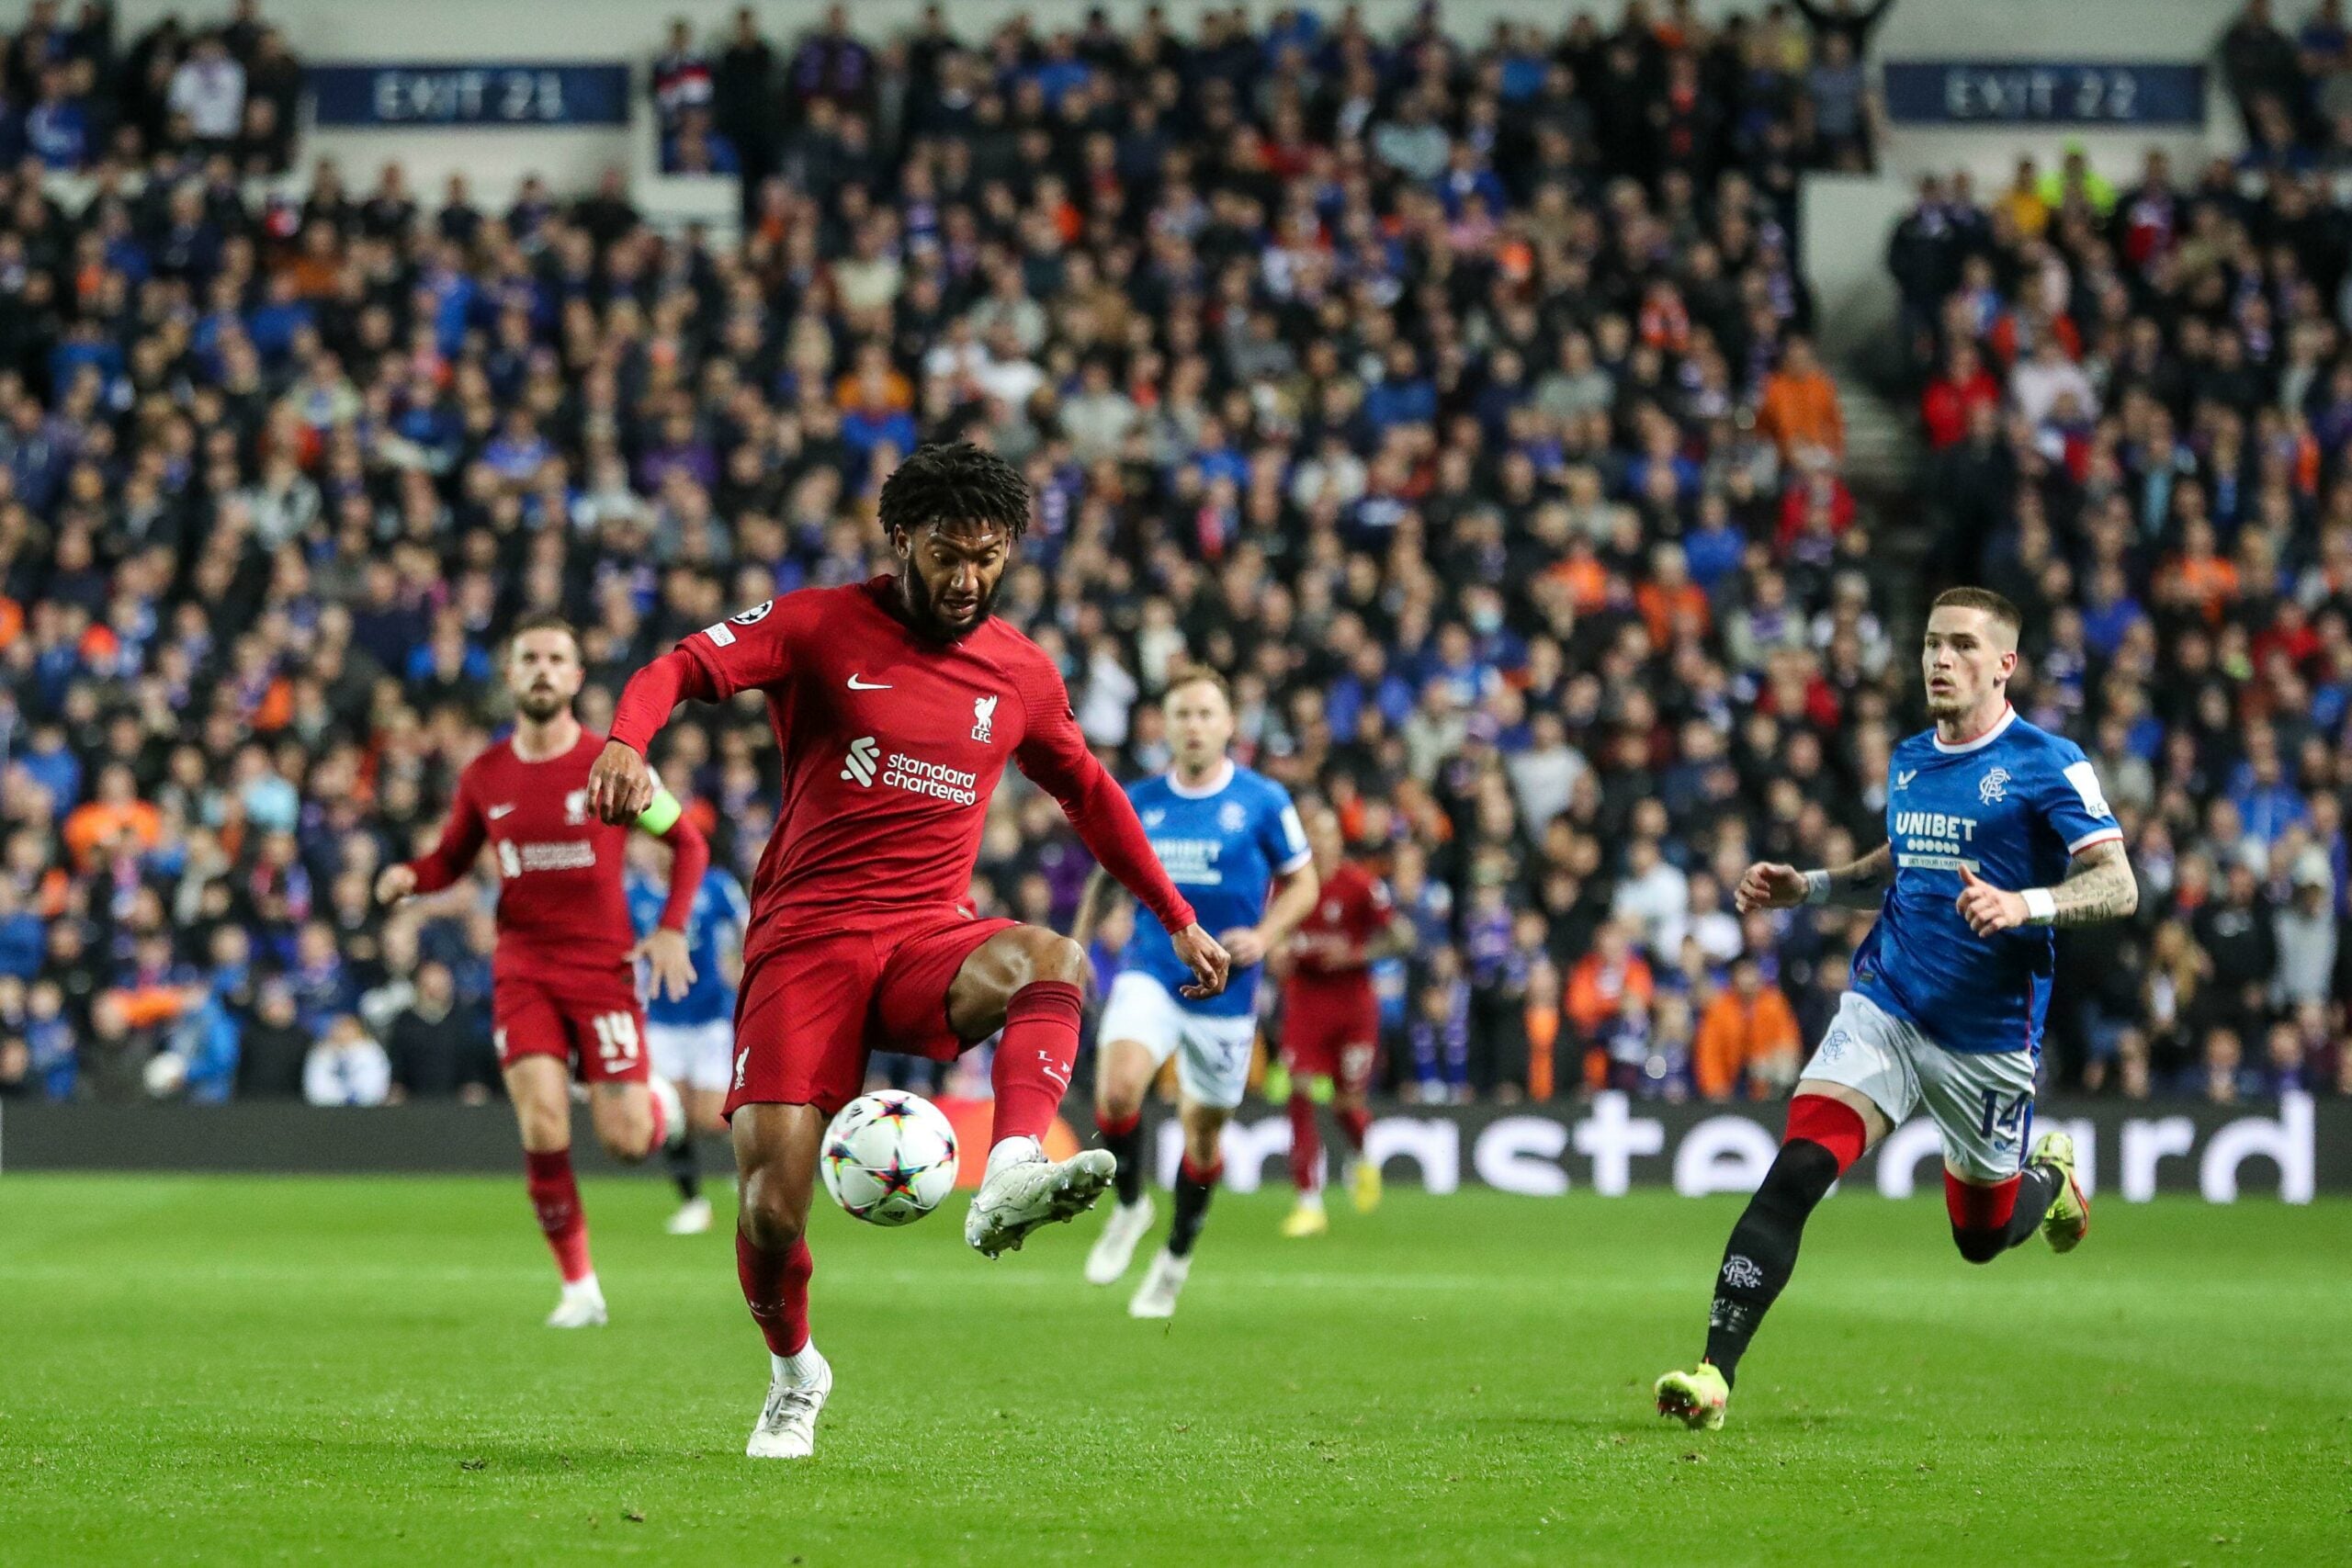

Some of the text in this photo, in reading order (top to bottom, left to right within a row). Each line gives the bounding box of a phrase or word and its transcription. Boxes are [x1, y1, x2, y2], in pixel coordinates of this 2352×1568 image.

[372, 69, 491, 120] EXIT
[1944, 66, 2138, 118] EXIT 22
[882, 770, 976, 806] chartered
[887, 752, 977, 789] standard
[1895, 811, 1977, 842] UNIBET
[592, 1011, 639, 1059] 14
[1981, 1089, 2030, 1139] 14
